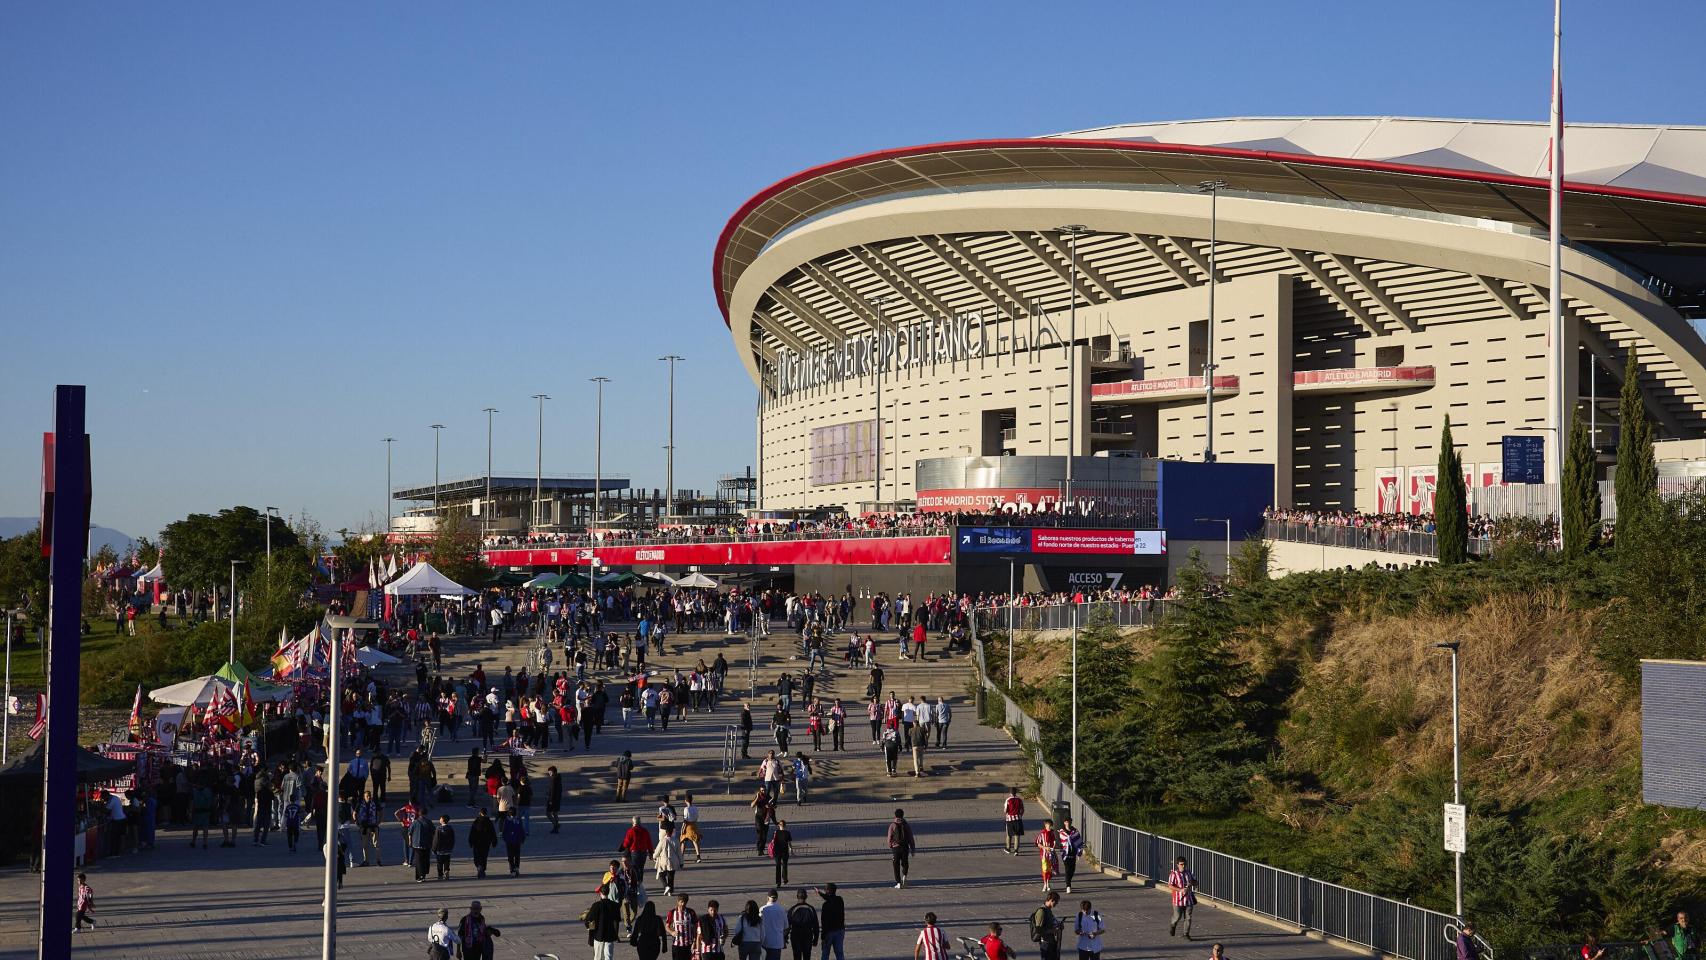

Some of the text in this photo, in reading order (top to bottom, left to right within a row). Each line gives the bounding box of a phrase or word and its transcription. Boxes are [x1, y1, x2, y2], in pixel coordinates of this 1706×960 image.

[833, 313, 985, 381] METROPOLITANO
[1361, 370, 1392, 378] MADRID
[935, 496, 943, 506] DE
[944, 496, 974, 506] MADRID
[1068, 572, 1124, 591] ACCESO 7
[288, 808, 298, 819] 17
